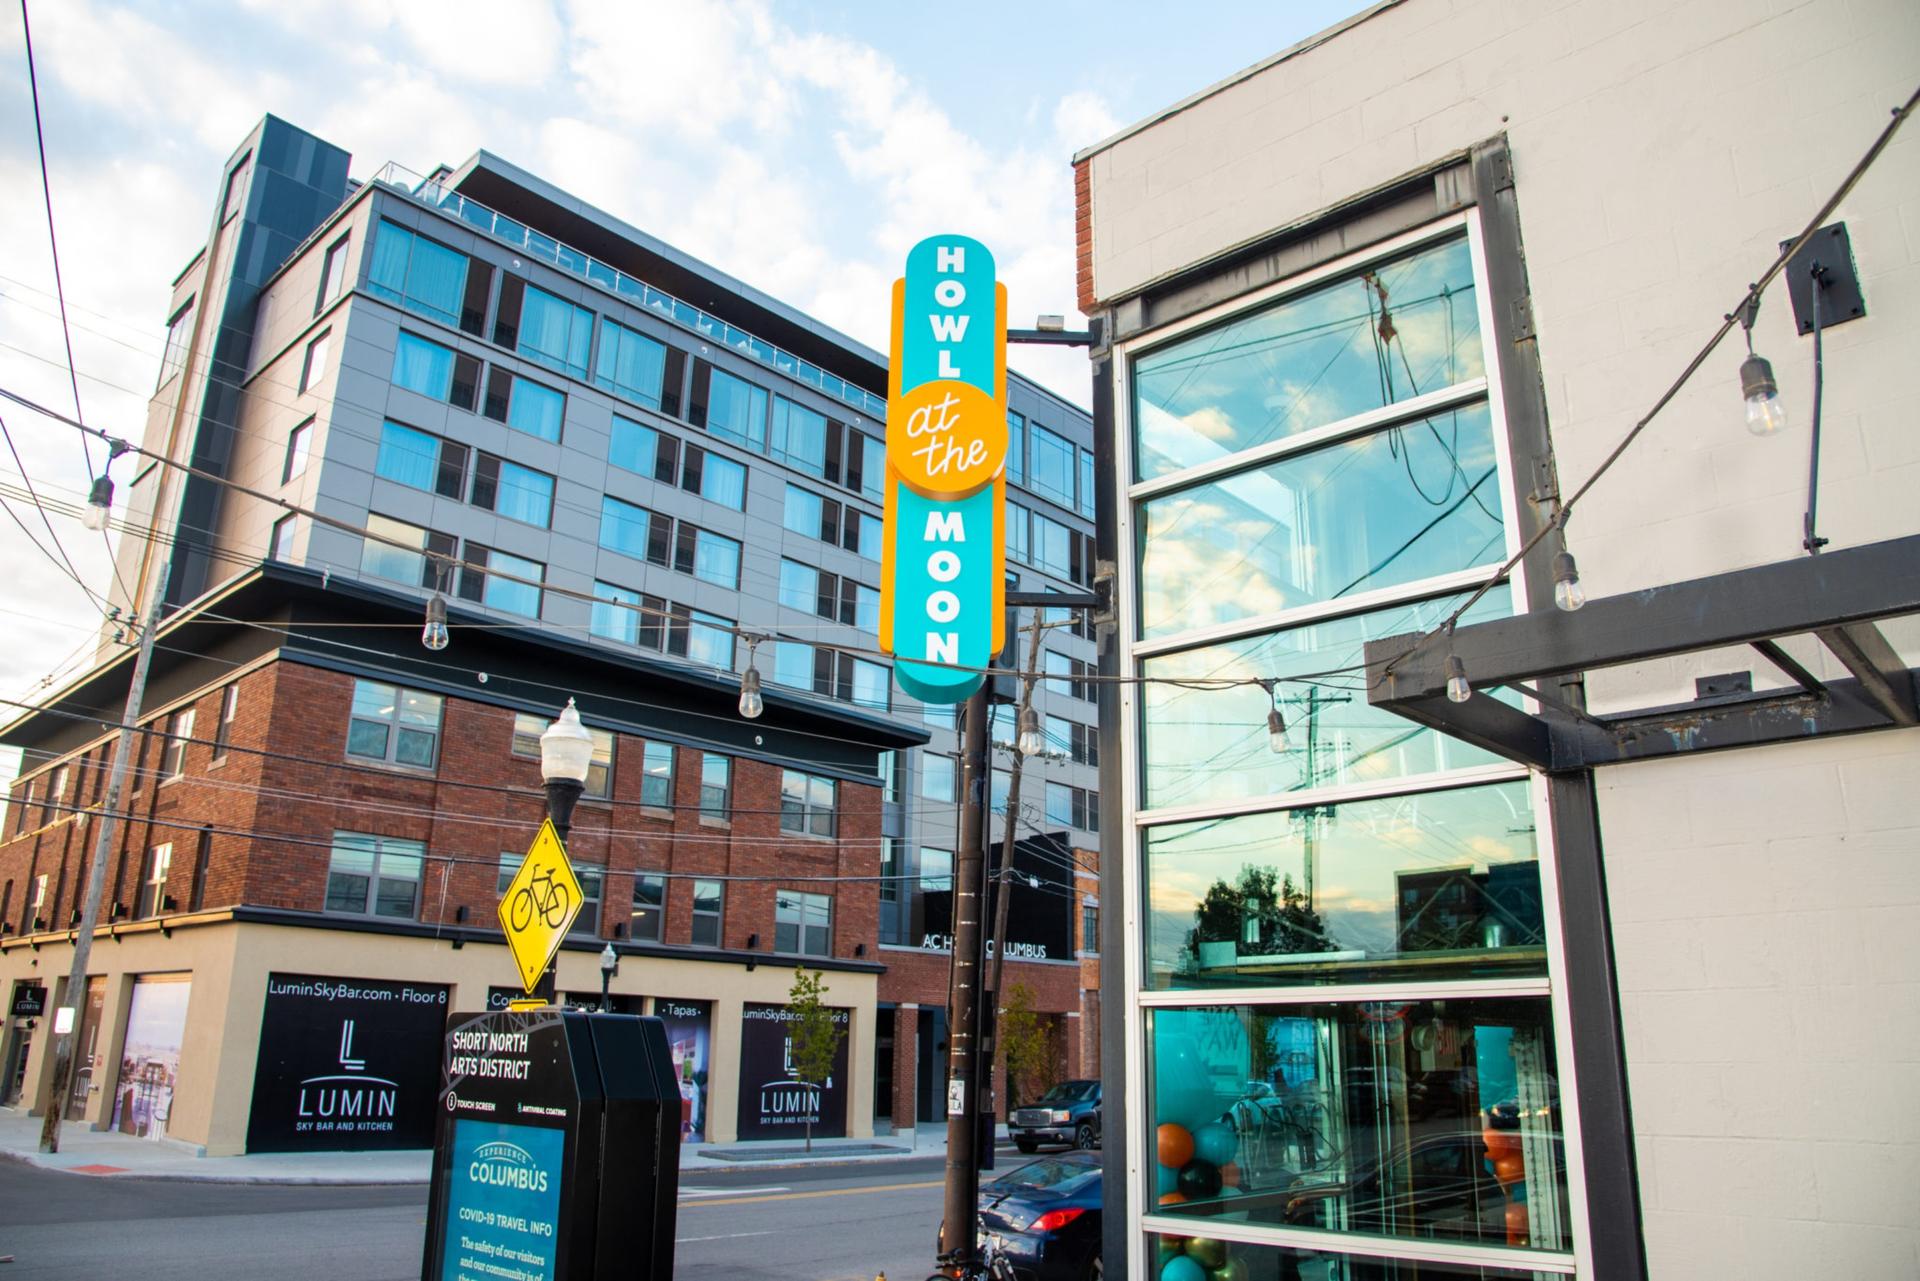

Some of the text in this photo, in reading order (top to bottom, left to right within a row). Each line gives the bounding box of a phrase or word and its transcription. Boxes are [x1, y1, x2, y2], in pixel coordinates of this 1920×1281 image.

[929, 246, 970, 378] HOWL
[907, 392, 960, 438] at
[912, 438, 987, 477] the
[923, 511, 966, 665] MOON
[923, 934, 940, 949] AC
[986, 939, 1047, 959] CLUMBUS
[269, 980, 447, 1004] LuminSkyBar.com Floor 8
[667, 1003, 697, 1017] Tapas
[842, 1012, 849, 1023] 8
[453, 1032, 528, 1052] SHORT NORTH
[450, 1057, 530, 1080] ARTS DISTRICT
[299, 1089, 396, 1117] LUMIN
[457, 1100, 496, 1112] TOUCH SCREEN
[545, 1107, 567, 1116] COATING
[761, 1091, 820, 1113] LUMIN
[296, 1122, 393, 1131] SKY BAR AND KITCHEN
[760, 1117, 771, 1125] SKY
[479, 1147, 527, 1164] EXPERIENCE
[469, 1162, 547, 1192] COLUMBUS
[459, 1207, 552, 1237] COVID-19 TRAVEL INFO
[461, 1236, 545, 1267] The safety of our visitors
[460, 1256, 474, 1269] and
[473, 1261, 486, 1272] our
[485, 1264, 526, 1281] community
